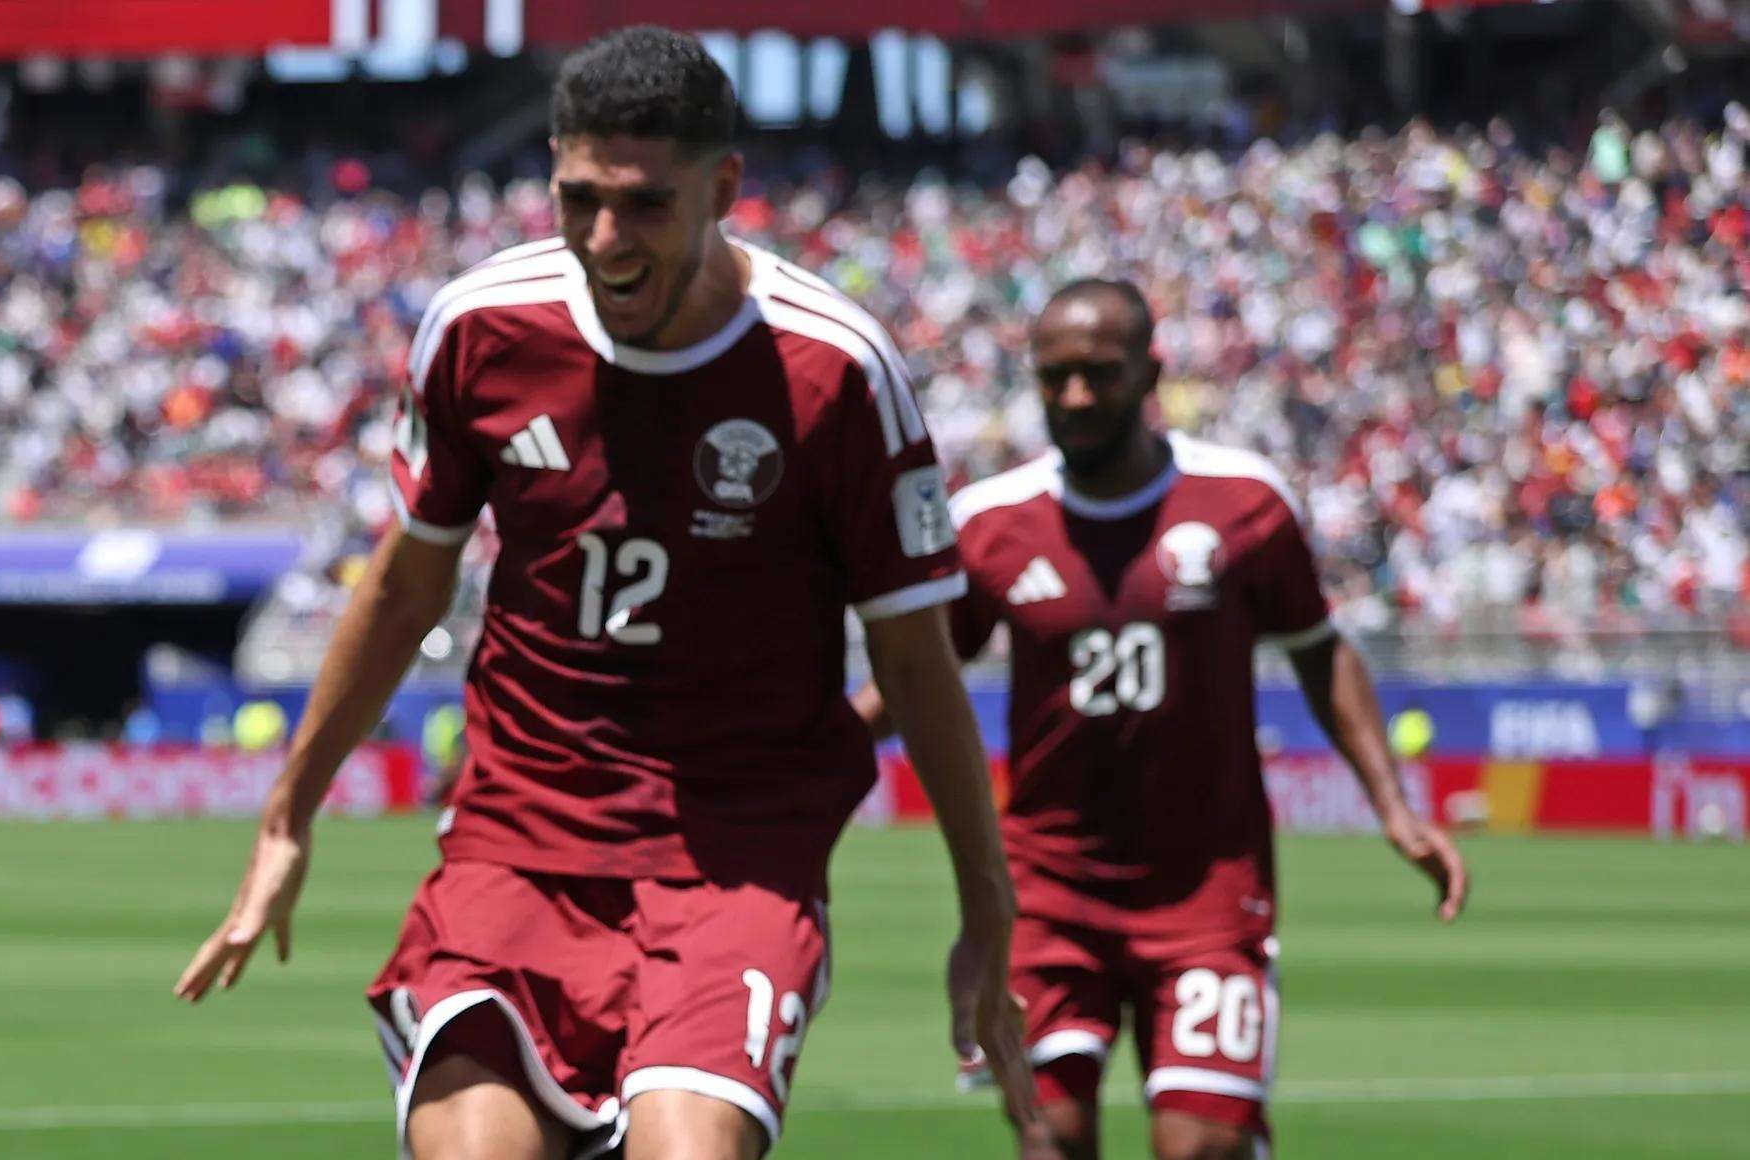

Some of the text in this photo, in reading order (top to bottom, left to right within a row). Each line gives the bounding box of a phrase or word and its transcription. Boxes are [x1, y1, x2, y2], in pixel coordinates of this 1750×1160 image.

[576, 531, 669, 645] 12
[1068, 621, 1166, 717] 20
[741, 967, 808, 1105] 12
[1171, 966, 1262, 1063] 20
